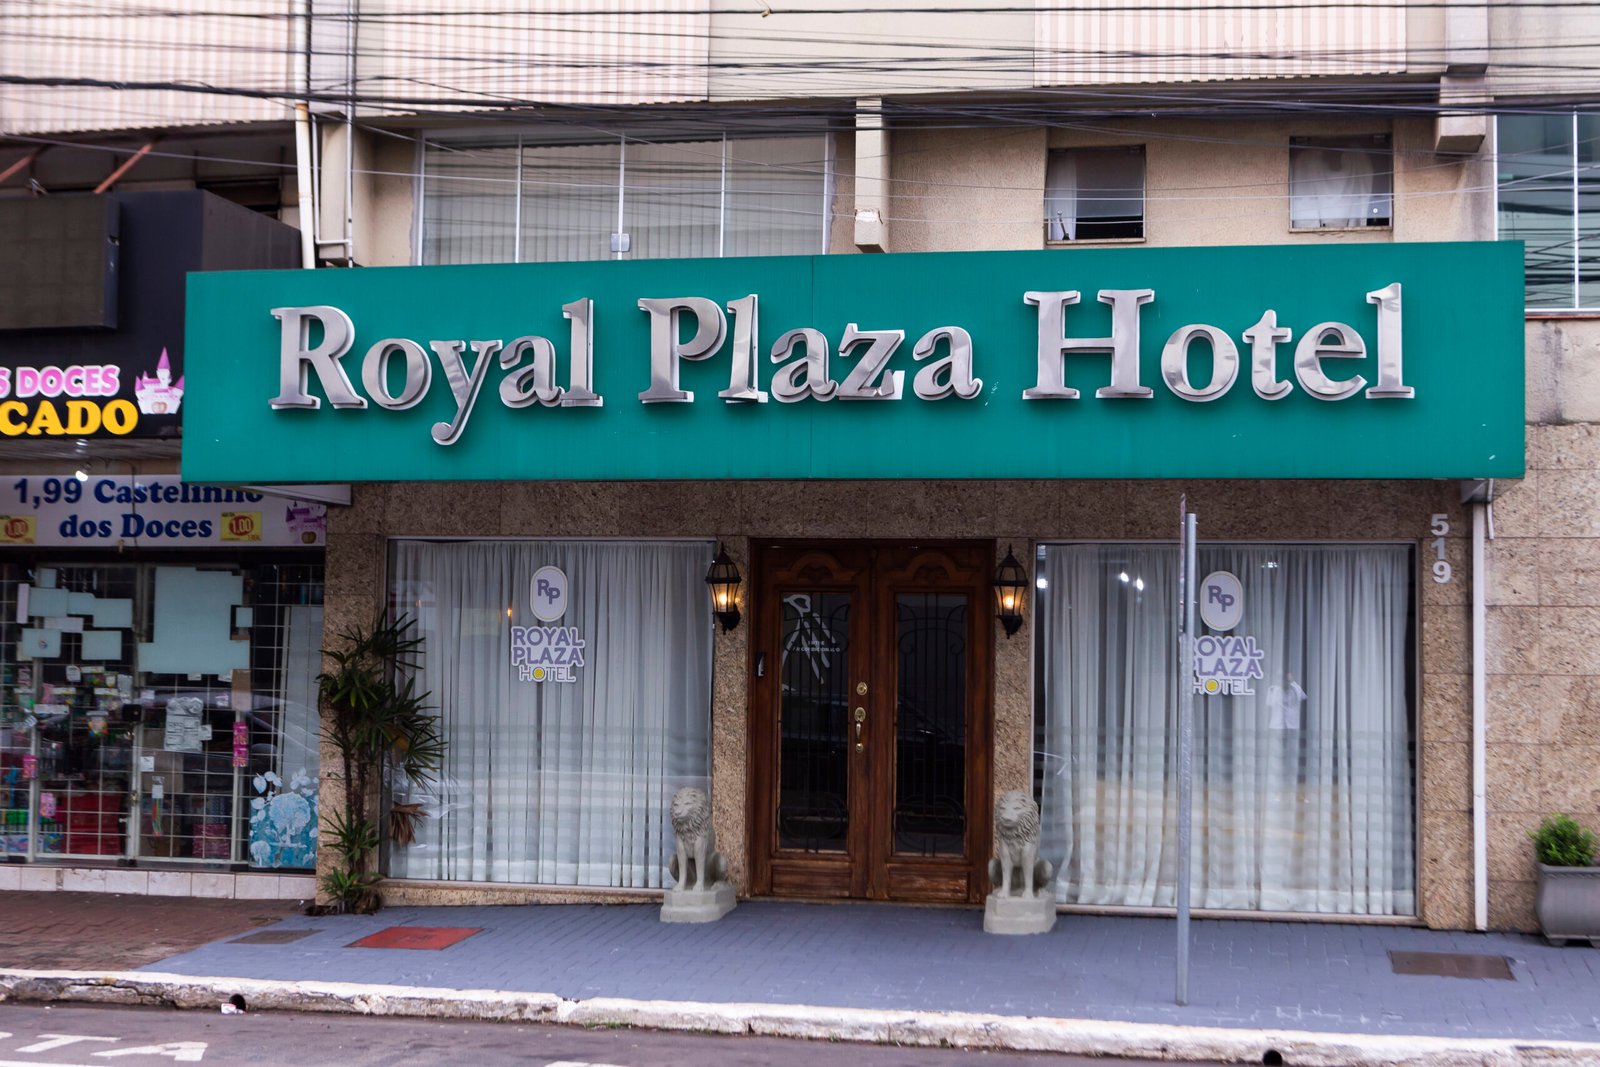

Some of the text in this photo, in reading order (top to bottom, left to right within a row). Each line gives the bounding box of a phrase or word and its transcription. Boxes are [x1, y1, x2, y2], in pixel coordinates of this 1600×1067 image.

[268, 282, 1416, 446] Royal Plaza Hotel
[16, 364, 120, 398] DOCES
[0, 399, 138, 436] CADO
[14, 478, 82, 509] 1,99
[59, 513, 212, 539] dos Doces
[1430, 513, 1451, 584] 519
[537, 579, 560, 605] RP
[1208, 585, 1235, 612] RP
[512, 628, 584, 646] ROYAL
[1193, 637, 1262, 657] OYAL
[512, 646, 583, 665] PLAZA
[1193, 657, 1262, 677] LAZA
[520, 665, 576, 681] HOTEL
